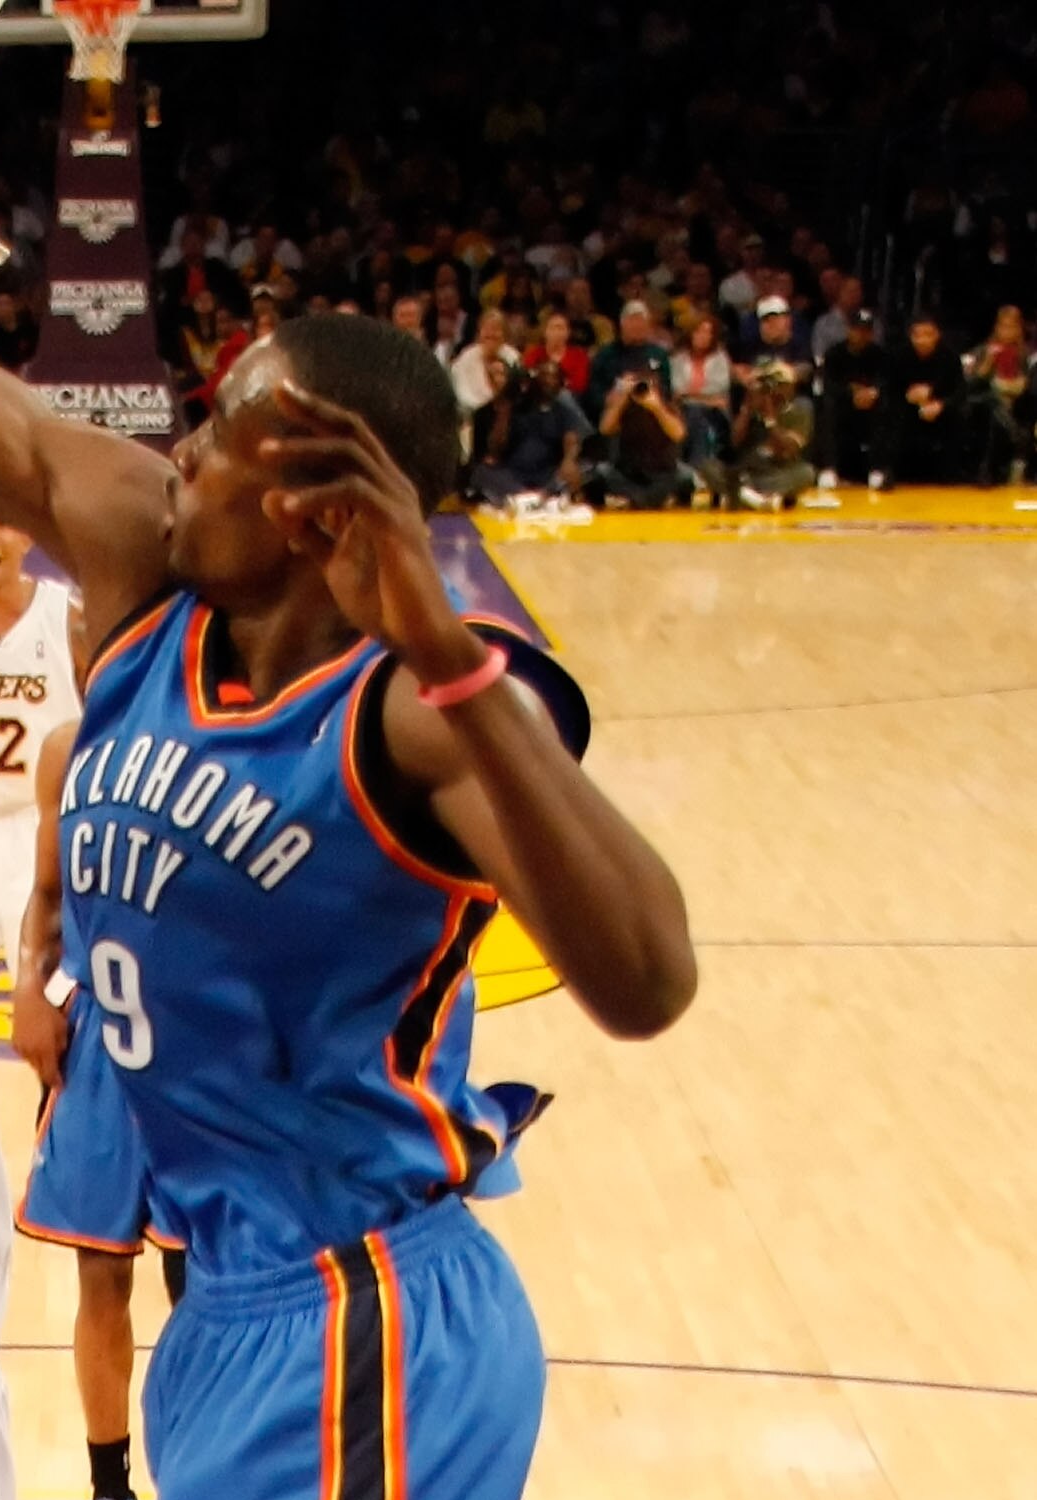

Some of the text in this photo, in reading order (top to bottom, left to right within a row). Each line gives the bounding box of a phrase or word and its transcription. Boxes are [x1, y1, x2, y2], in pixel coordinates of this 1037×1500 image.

[60, 735, 313, 892] KLAHOMA
[69, 821, 185, 914] CITY
[90, 938, 155, 1071] 9
